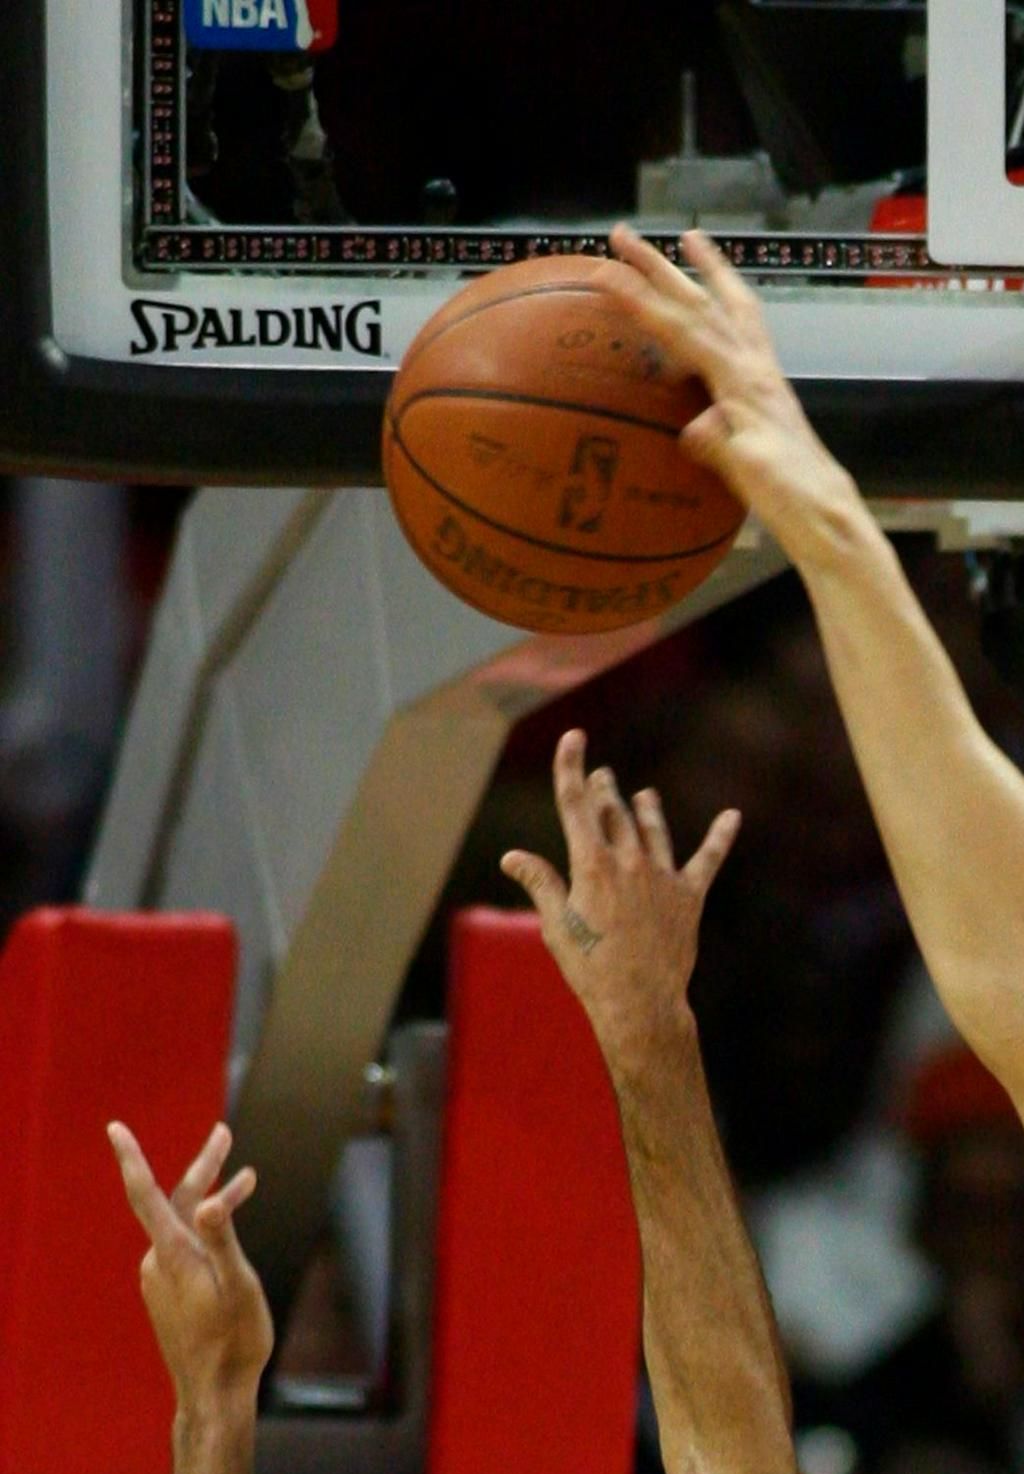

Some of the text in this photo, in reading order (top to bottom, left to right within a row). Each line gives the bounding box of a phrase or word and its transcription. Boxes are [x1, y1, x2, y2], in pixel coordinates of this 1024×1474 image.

[202, 0, 288, 29] NBA
[130, 299, 382, 357] SPALDING
[432, 516, 681, 615] SPALDING
